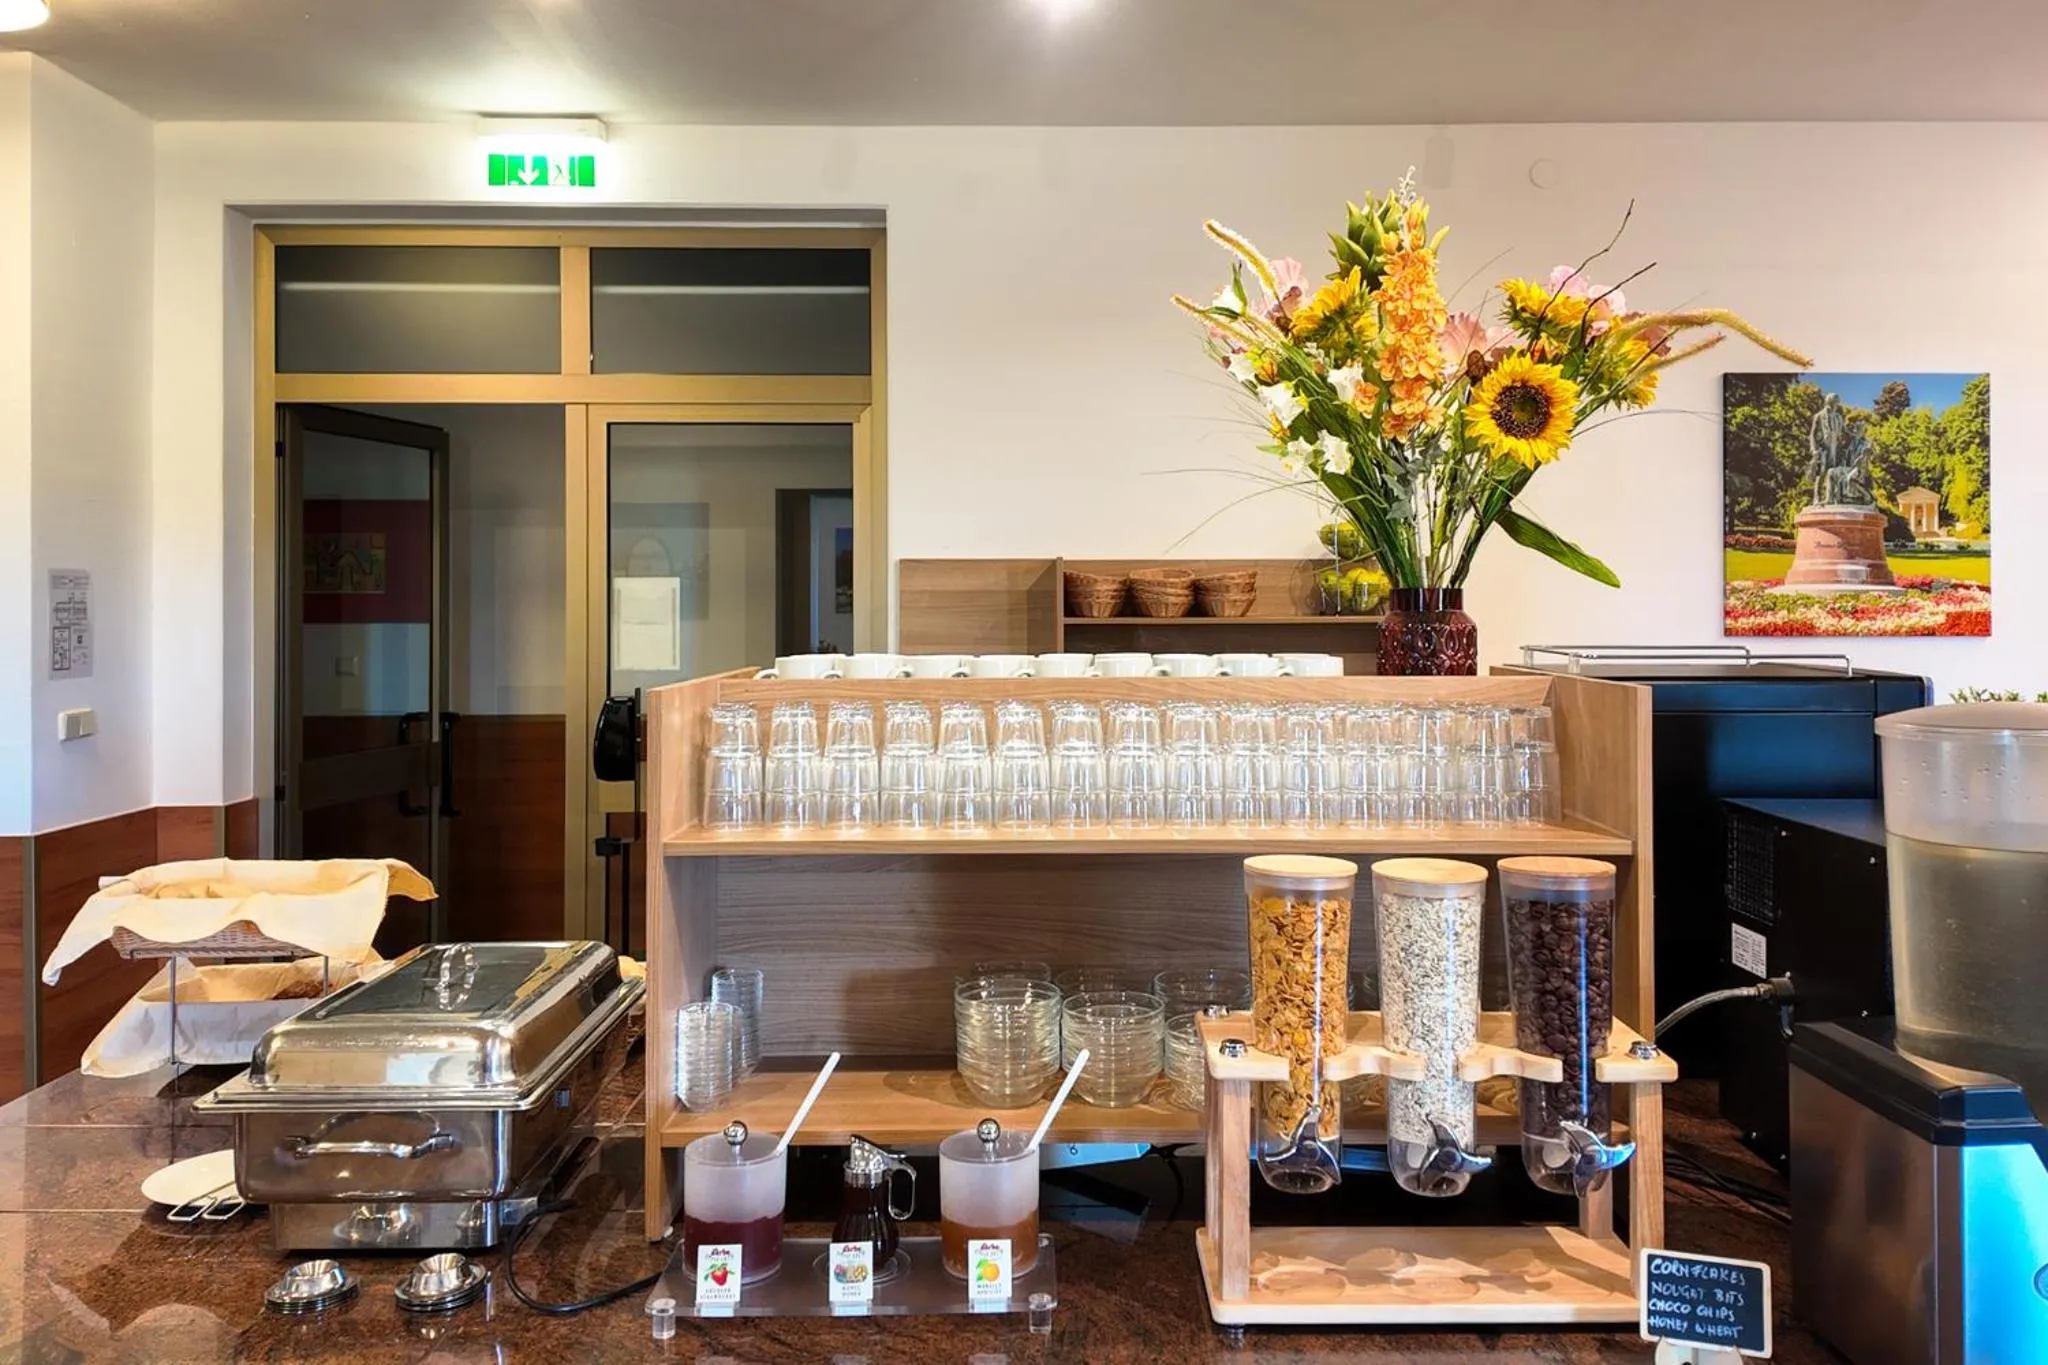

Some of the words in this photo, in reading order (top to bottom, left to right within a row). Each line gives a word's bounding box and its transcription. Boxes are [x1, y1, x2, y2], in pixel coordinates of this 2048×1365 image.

[1651, 1281, 1705, 1300] NOUGAT
[1713, 1288, 1745, 1306] BITS
[1648, 1298, 1692, 1314] CHOCO
[1696, 1304, 1735, 1322] CHIPS
[1648, 1315, 1688, 1333] HONEY
[1695, 1323, 1744, 1338] WHEAT
